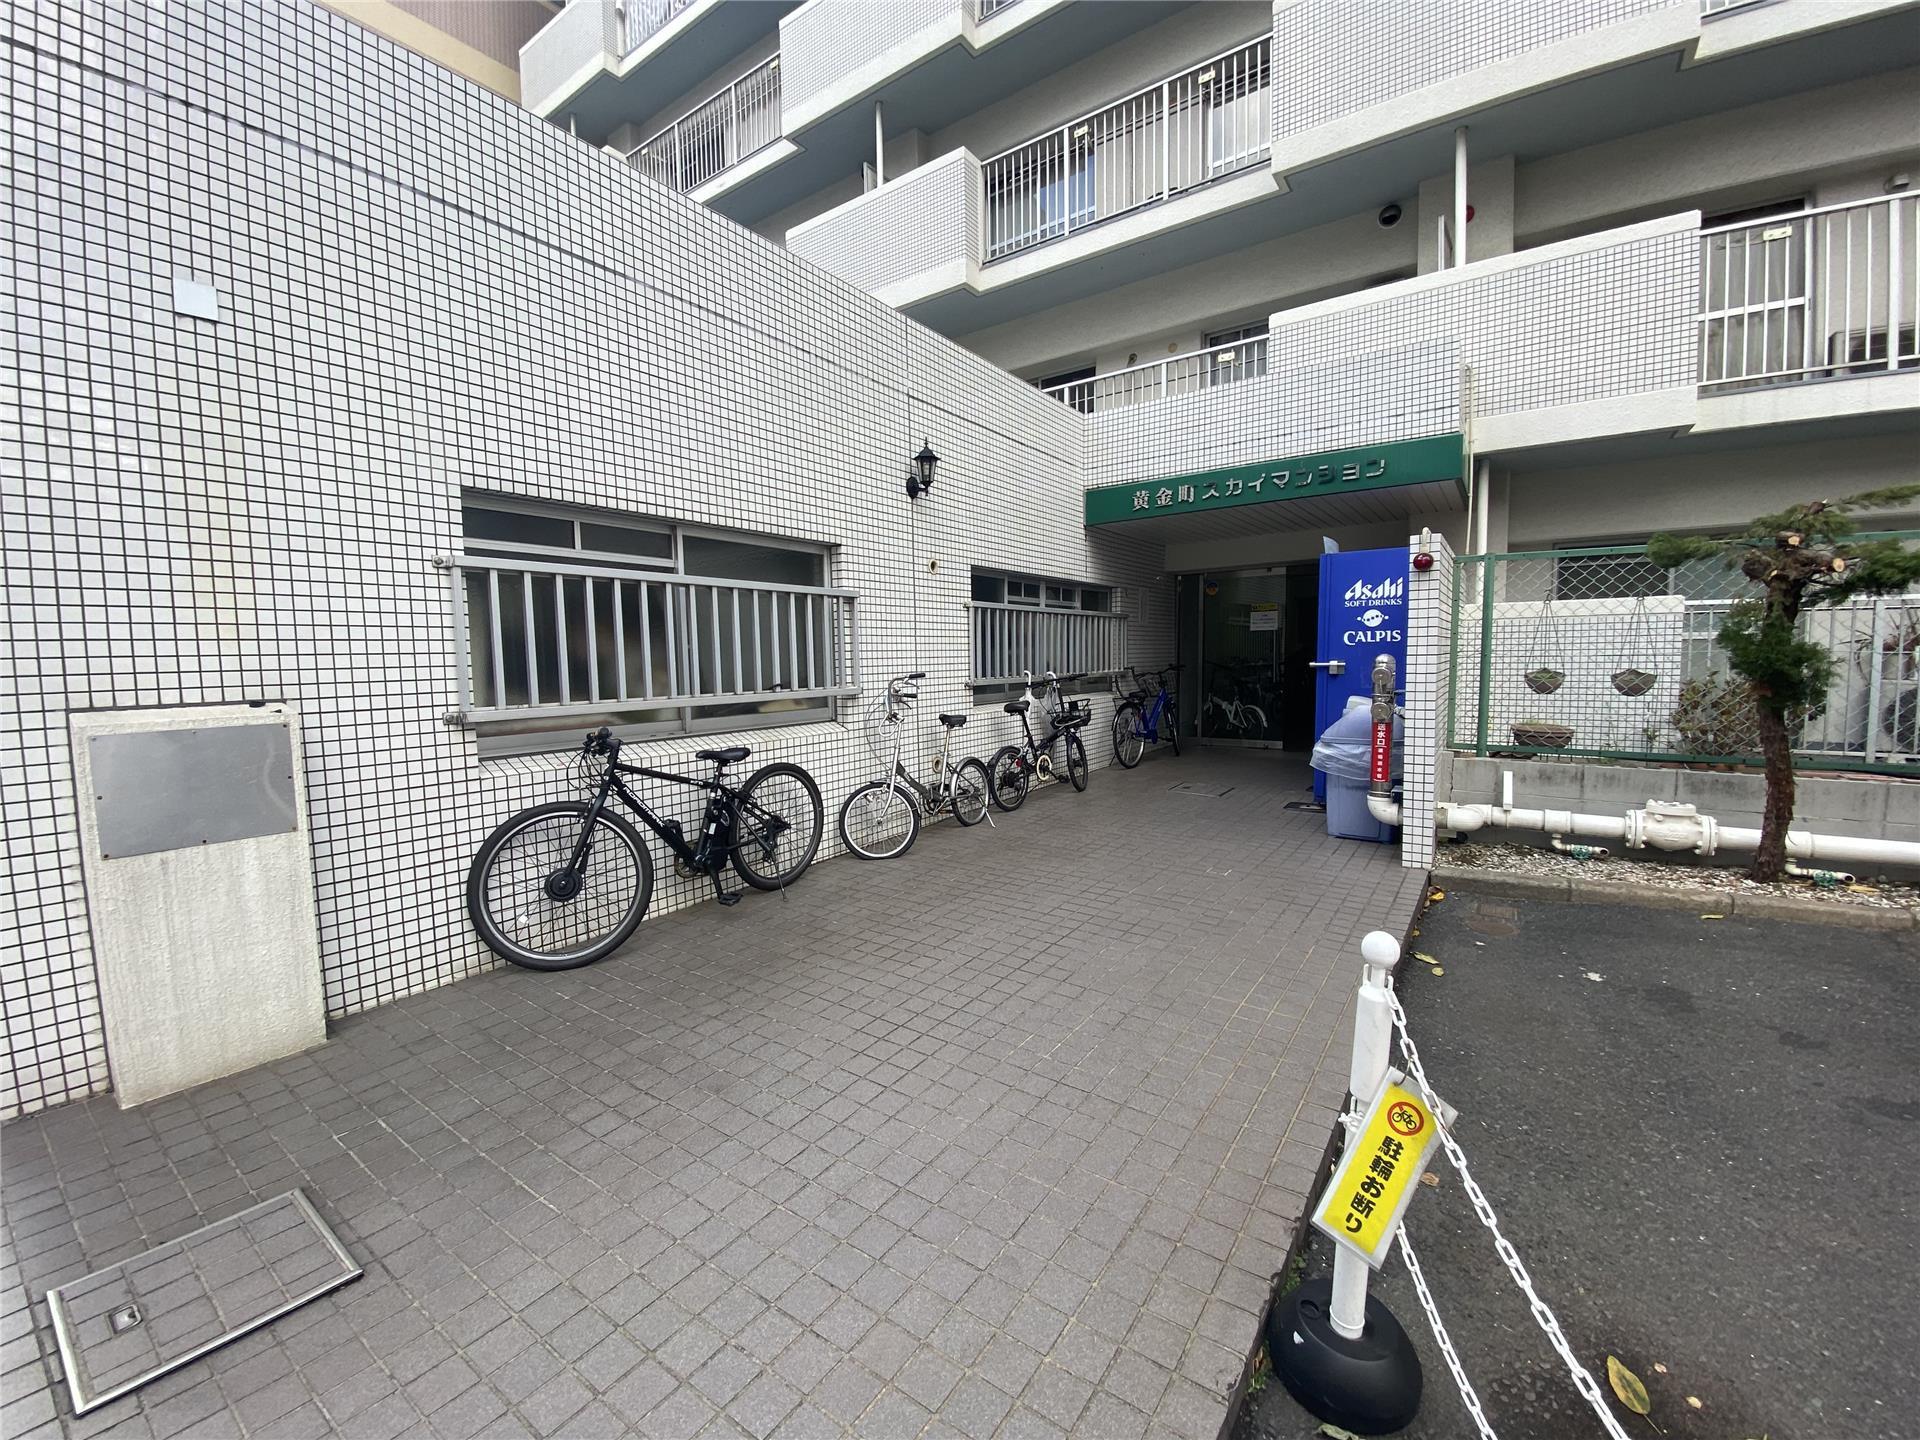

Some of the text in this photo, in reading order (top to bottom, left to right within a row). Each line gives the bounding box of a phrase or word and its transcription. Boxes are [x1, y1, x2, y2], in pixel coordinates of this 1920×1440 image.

[1131, 459, 1386, 512] 黄金町スカイマンション
[1344, 576, 1403, 600] Asahi
[1344, 598, 1403, 608] SOFT DRINKS
[1343, 630, 1402, 645] CALPIS
[1345, 1135, 1404, 1233] 駐輪お断り
